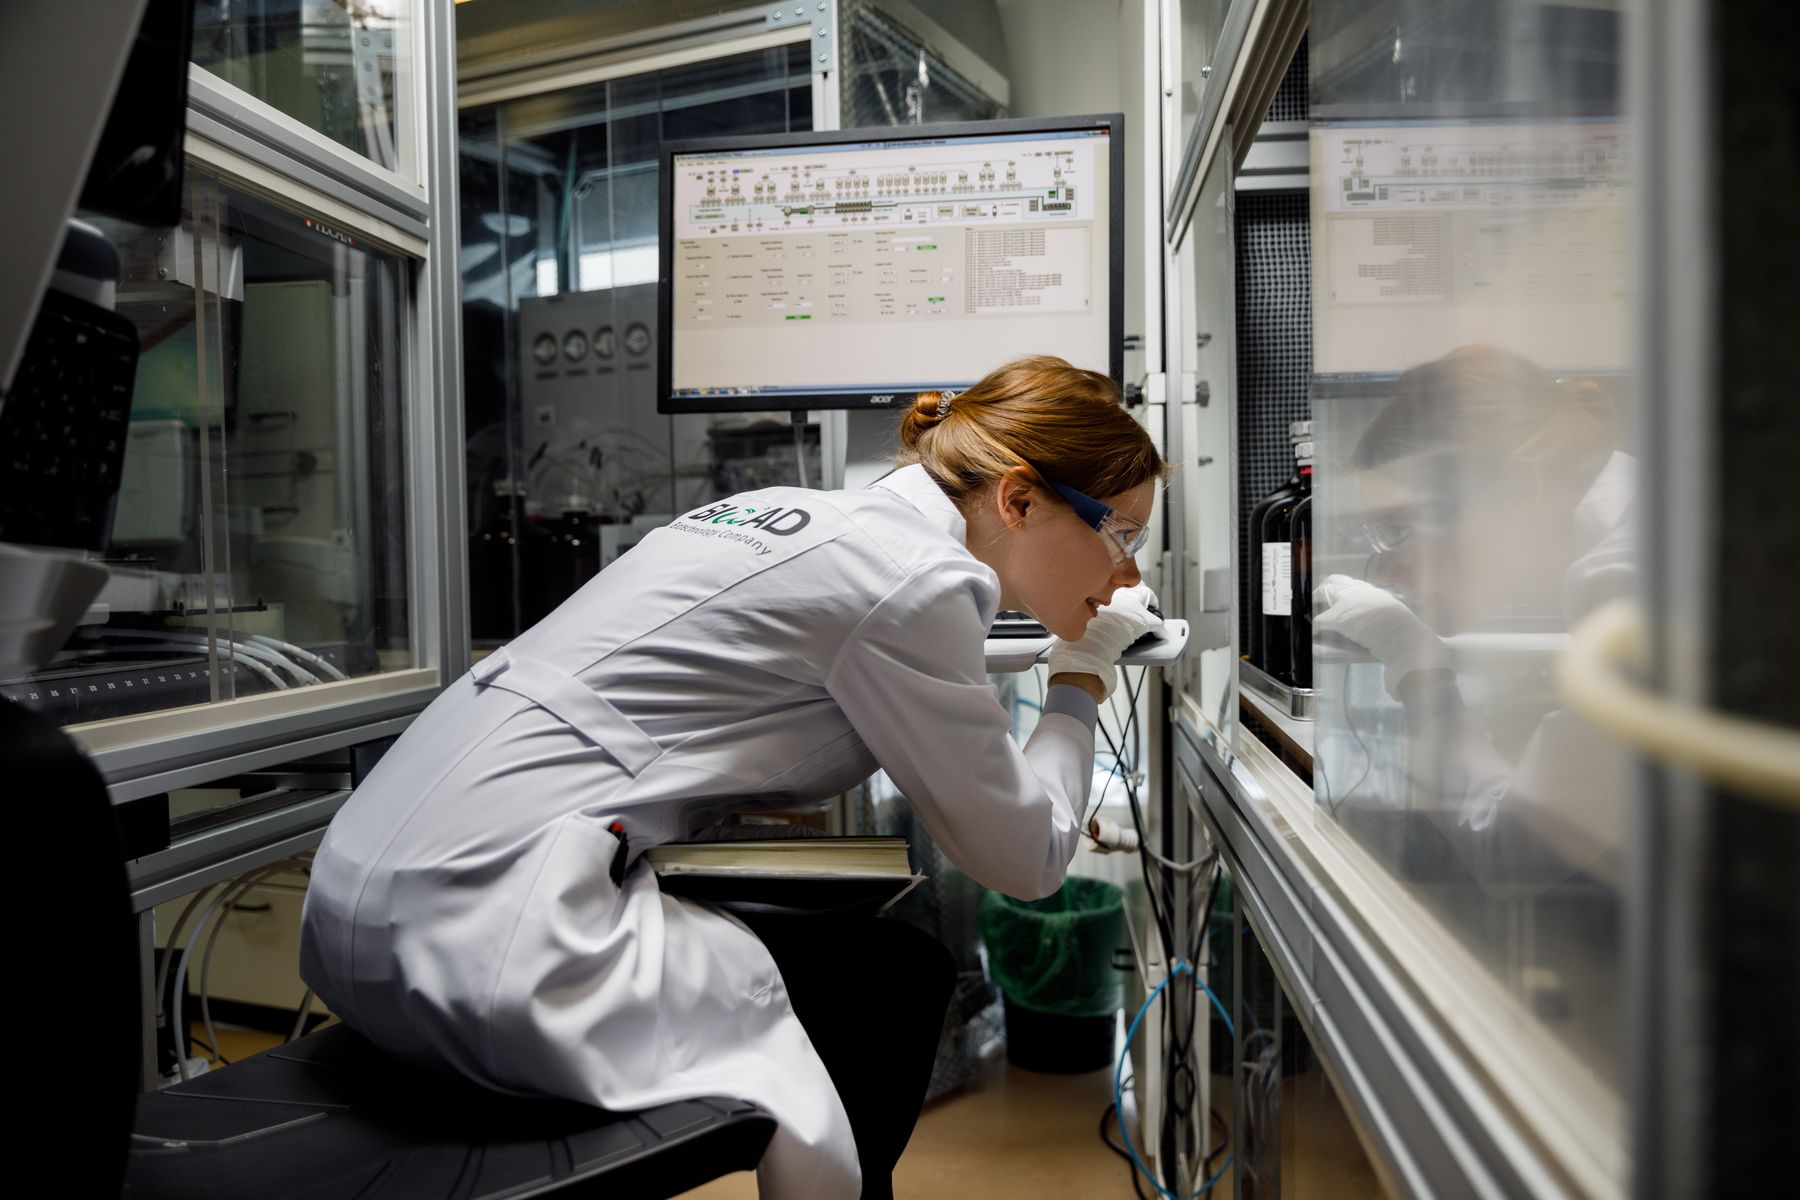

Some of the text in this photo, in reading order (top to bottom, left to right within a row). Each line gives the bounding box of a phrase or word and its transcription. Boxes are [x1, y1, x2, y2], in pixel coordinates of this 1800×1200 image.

[870, 395, 895, 404] acer
[669, 521, 772, 556] Biotechnology Company
